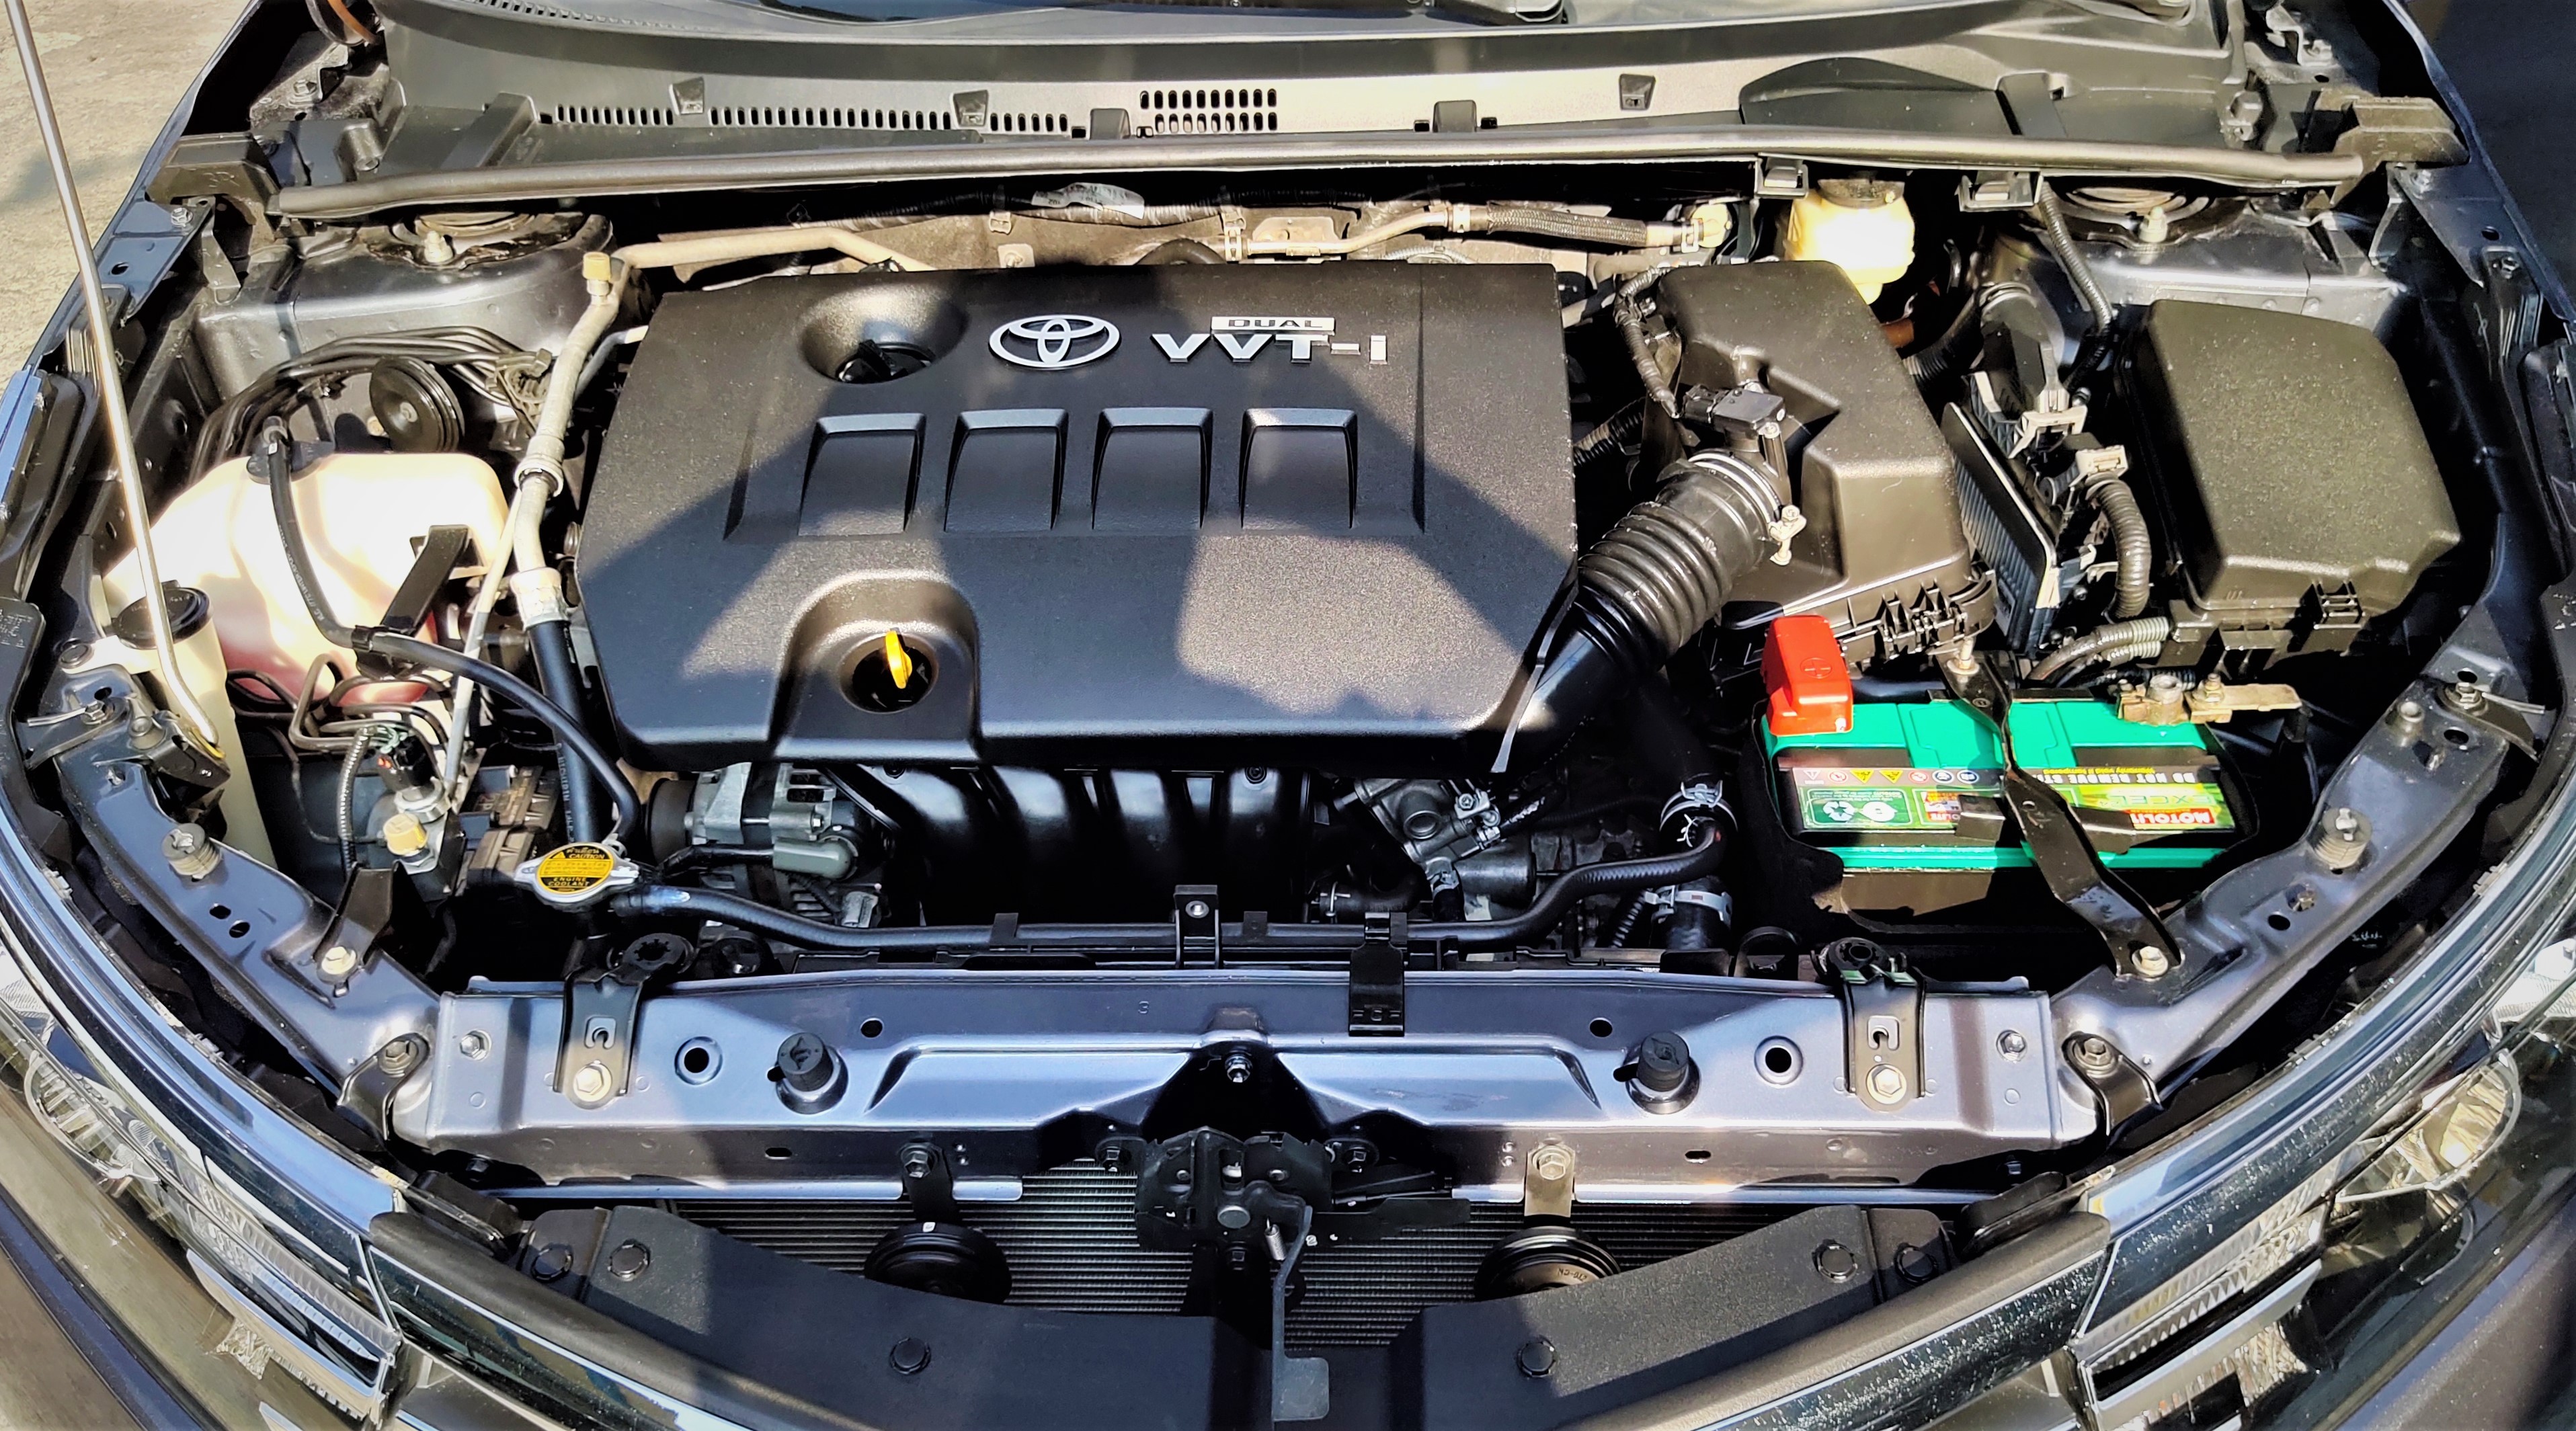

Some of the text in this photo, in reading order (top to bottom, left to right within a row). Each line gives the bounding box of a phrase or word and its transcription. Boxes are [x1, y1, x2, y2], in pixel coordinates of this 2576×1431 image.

[1227, 319, 1324, 329] DUAL
[2067, 773, 2131, 784] REMOVE
[2136, 772, 2168, 784] NOT
[2172, 772, 2196, 784] DO
[2109, 795, 2214, 805] EXCEL
[2130, 811, 2212, 825] MOTOLIT
